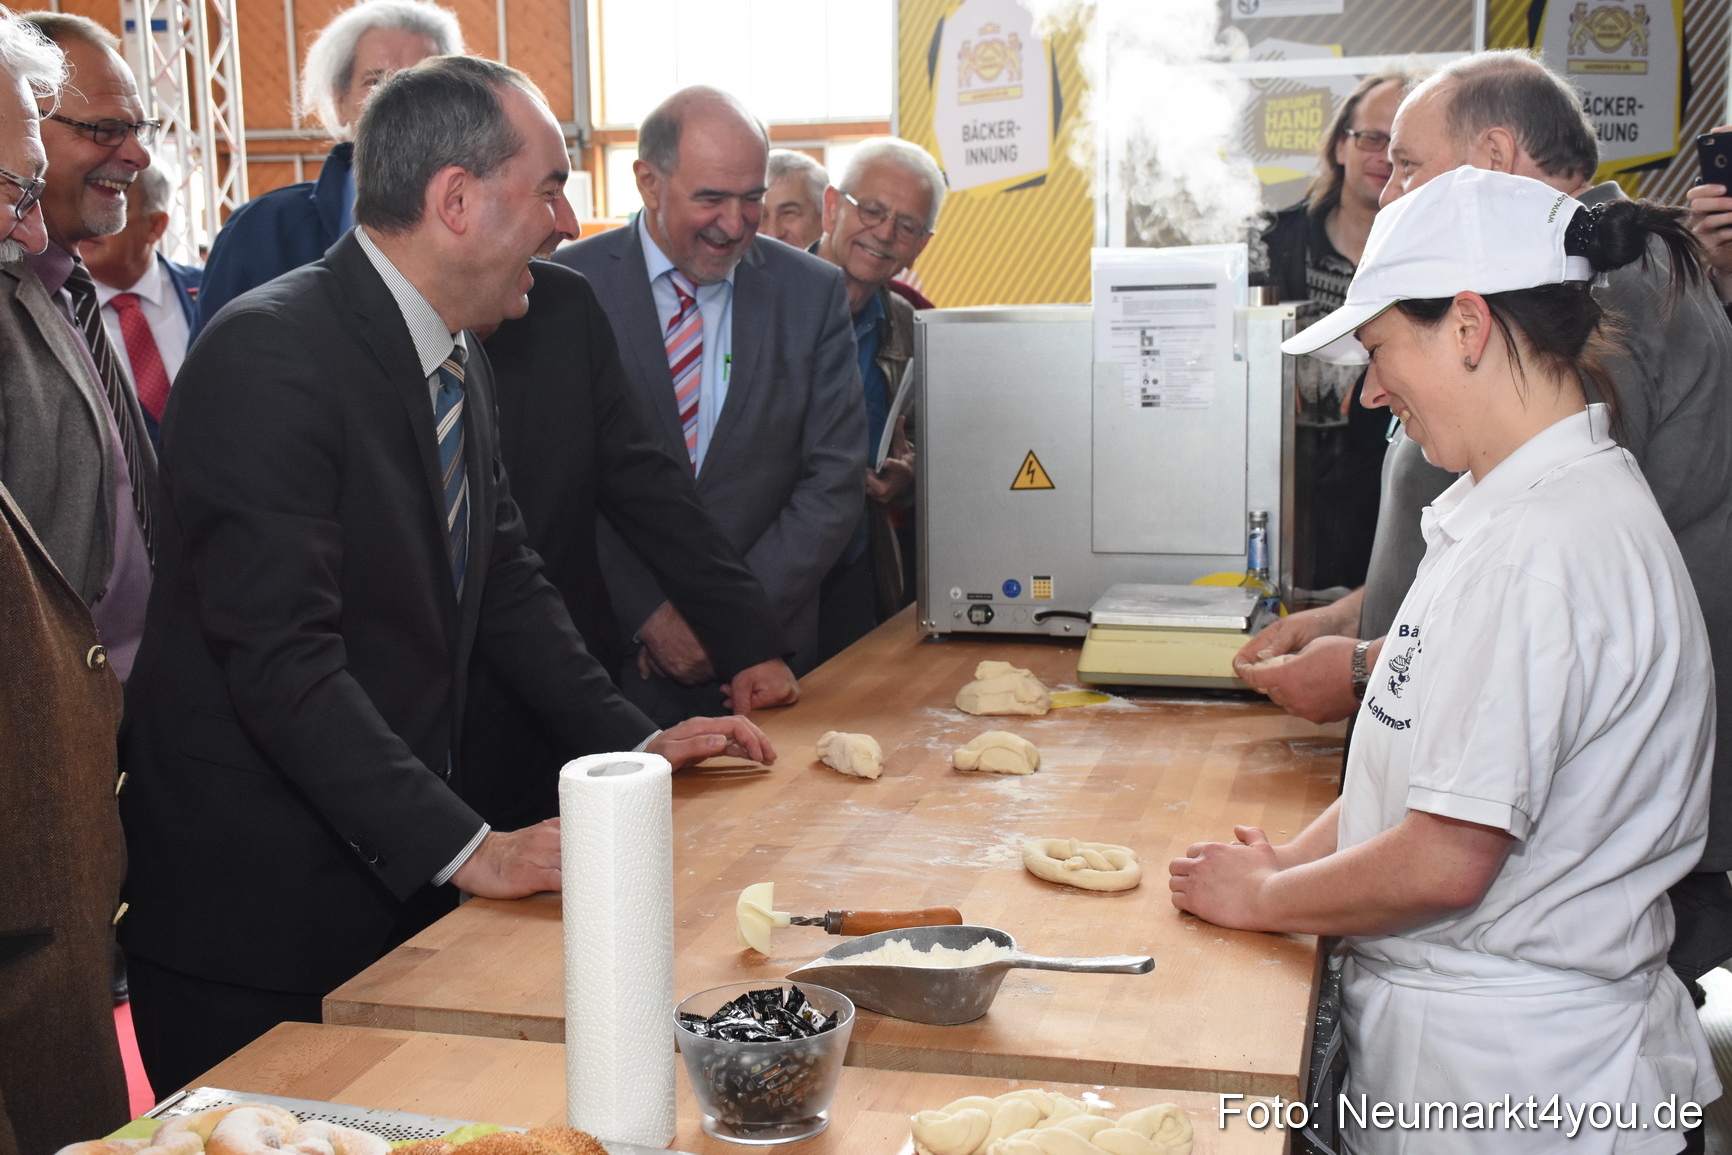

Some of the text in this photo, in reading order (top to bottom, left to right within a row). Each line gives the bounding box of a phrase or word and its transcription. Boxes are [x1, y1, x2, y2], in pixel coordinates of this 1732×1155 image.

[1266, 94, 1322, 112] ZUKUNFT
[1583, 91, 1644, 117] ÄCKER-
[1265, 108, 1322, 129] HAND
[962, 118, 1021, 143] BÄCKER-
[1264, 130, 1322, 149] WERK
[965, 145, 1018, 166] INNUNG
[1399, 624, 1420, 638] Bä
[1367, 696, 1412, 731] Lehmer
